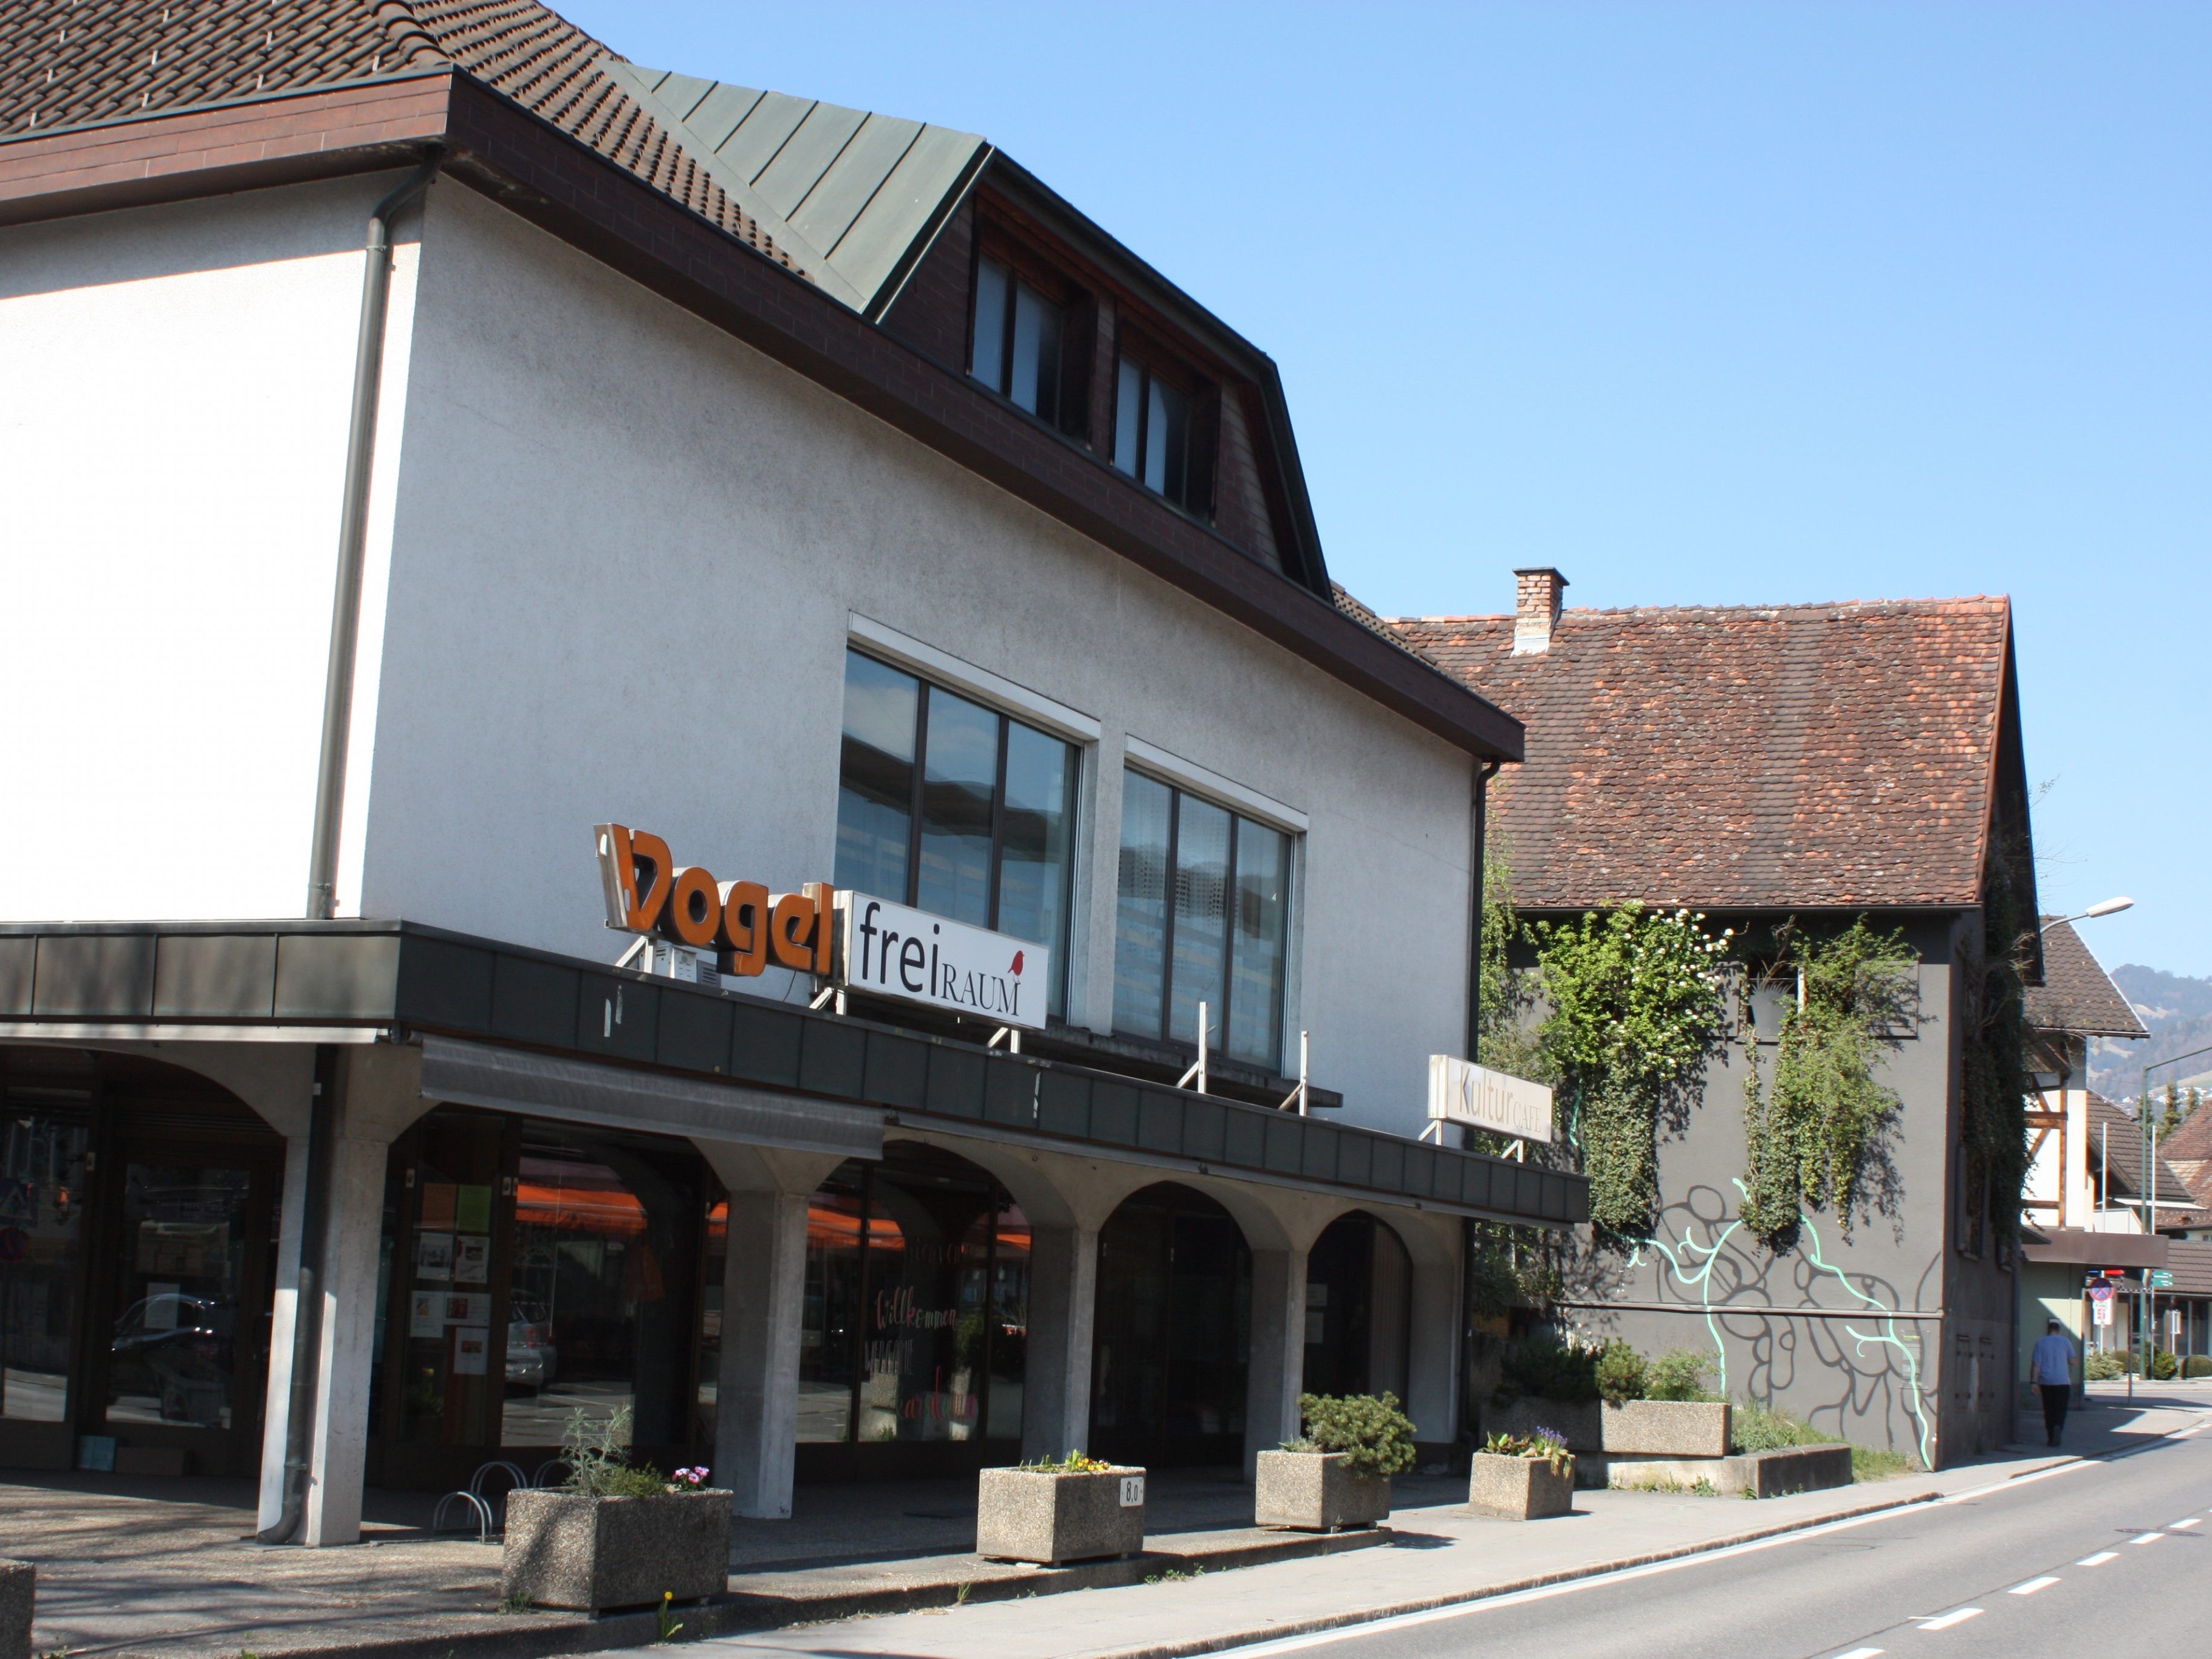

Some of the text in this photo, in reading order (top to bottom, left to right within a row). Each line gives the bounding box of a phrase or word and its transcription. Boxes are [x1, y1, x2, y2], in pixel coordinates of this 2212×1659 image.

[595, 824, 834, 977] Vogel
[875, 1285, 957, 1330] Willkommen
[1126, 1480, 1139, 1503] 8,0
